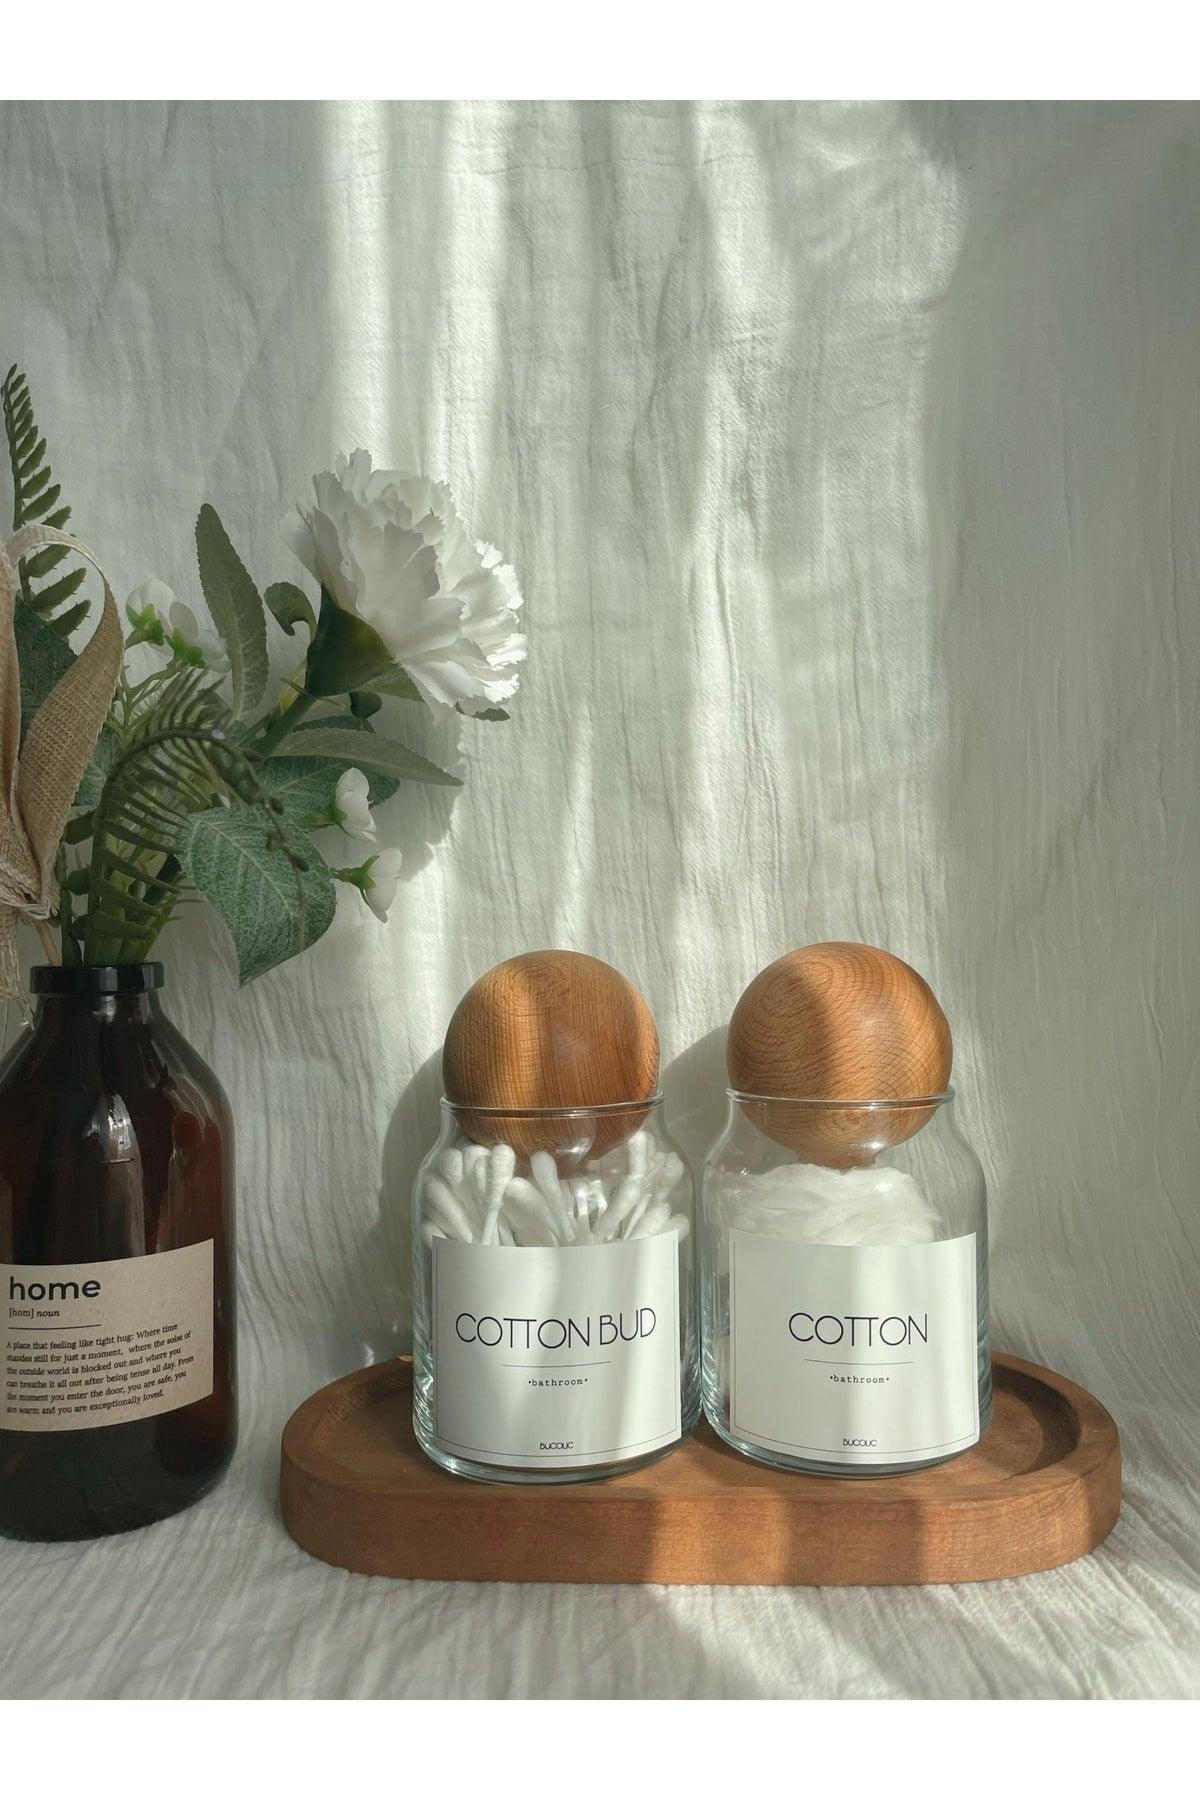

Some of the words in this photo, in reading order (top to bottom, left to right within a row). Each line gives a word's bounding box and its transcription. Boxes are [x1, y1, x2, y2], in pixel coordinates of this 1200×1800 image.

[10, 1276, 101, 1300] home
[13, 1341, 31, 1350] place
[50, 1341, 77, 1350] feeling
[78, 1339, 94, 1347] like
[96, 1336, 115, 1347] tight
[136, 1329, 160, 1338] Where
[162, 1324, 178, 1333] time
[456, 1312, 590, 1349] COTTON
[600, 1307, 656, 1345] BUD
[788, 1312, 927, 1347] COTTON
[34, 1354, 48, 1362] still
[50, 1354, 62, 1362] for
[63, 1353, 79, 1363] just
[88, 1349, 123, 1360] moment,
[128, 1343, 152, 1353] where
[154, 1339, 165, 1348] the
[184, 1330, 192, 1338] of
[7, 1367, 17, 1375] the
[47, 1367, 70, 1375] world
[72, 1366, 79, 1374] is
[81, 1362, 112, 1373] blocked
[114, 1361, 127, 1369] out
[129, 1356, 143, 1366] and
[145, 1352, 167, 1362] where
[169, 1348, 181, 1358] you
[19, 1380, 47, 1388] breathe
[69, 1379, 82, 1387] out
[85, 1377, 104, 1386] after
[107, 1373, 128, 1383] being
[130, 1369, 150, 1379] tense
[152, 1364, 161, 1374] all
[178, 1356, 194, 1366] From
[50, 1394, 65, 1403] you
[67, 1392, 88, 1400] enter
[90, 1390, 103, 1398] the
[105, 1388, 125, 1396] door,
[127, 1383, 141, 1393] you
[143, 1380, 155, 1389] are
[157, 1375, 173, 1385] safe,
[175, 1371, 187, 1381] you
[41, 1406, 56, 1414] and
[57, 1406, 72, 1415] you
[89, 1395, 141, 1411] exceptionally
[540, 1441, 574, 1450] BUCOLIC
[843, 1438, 878, 1447] BUCOLIC
